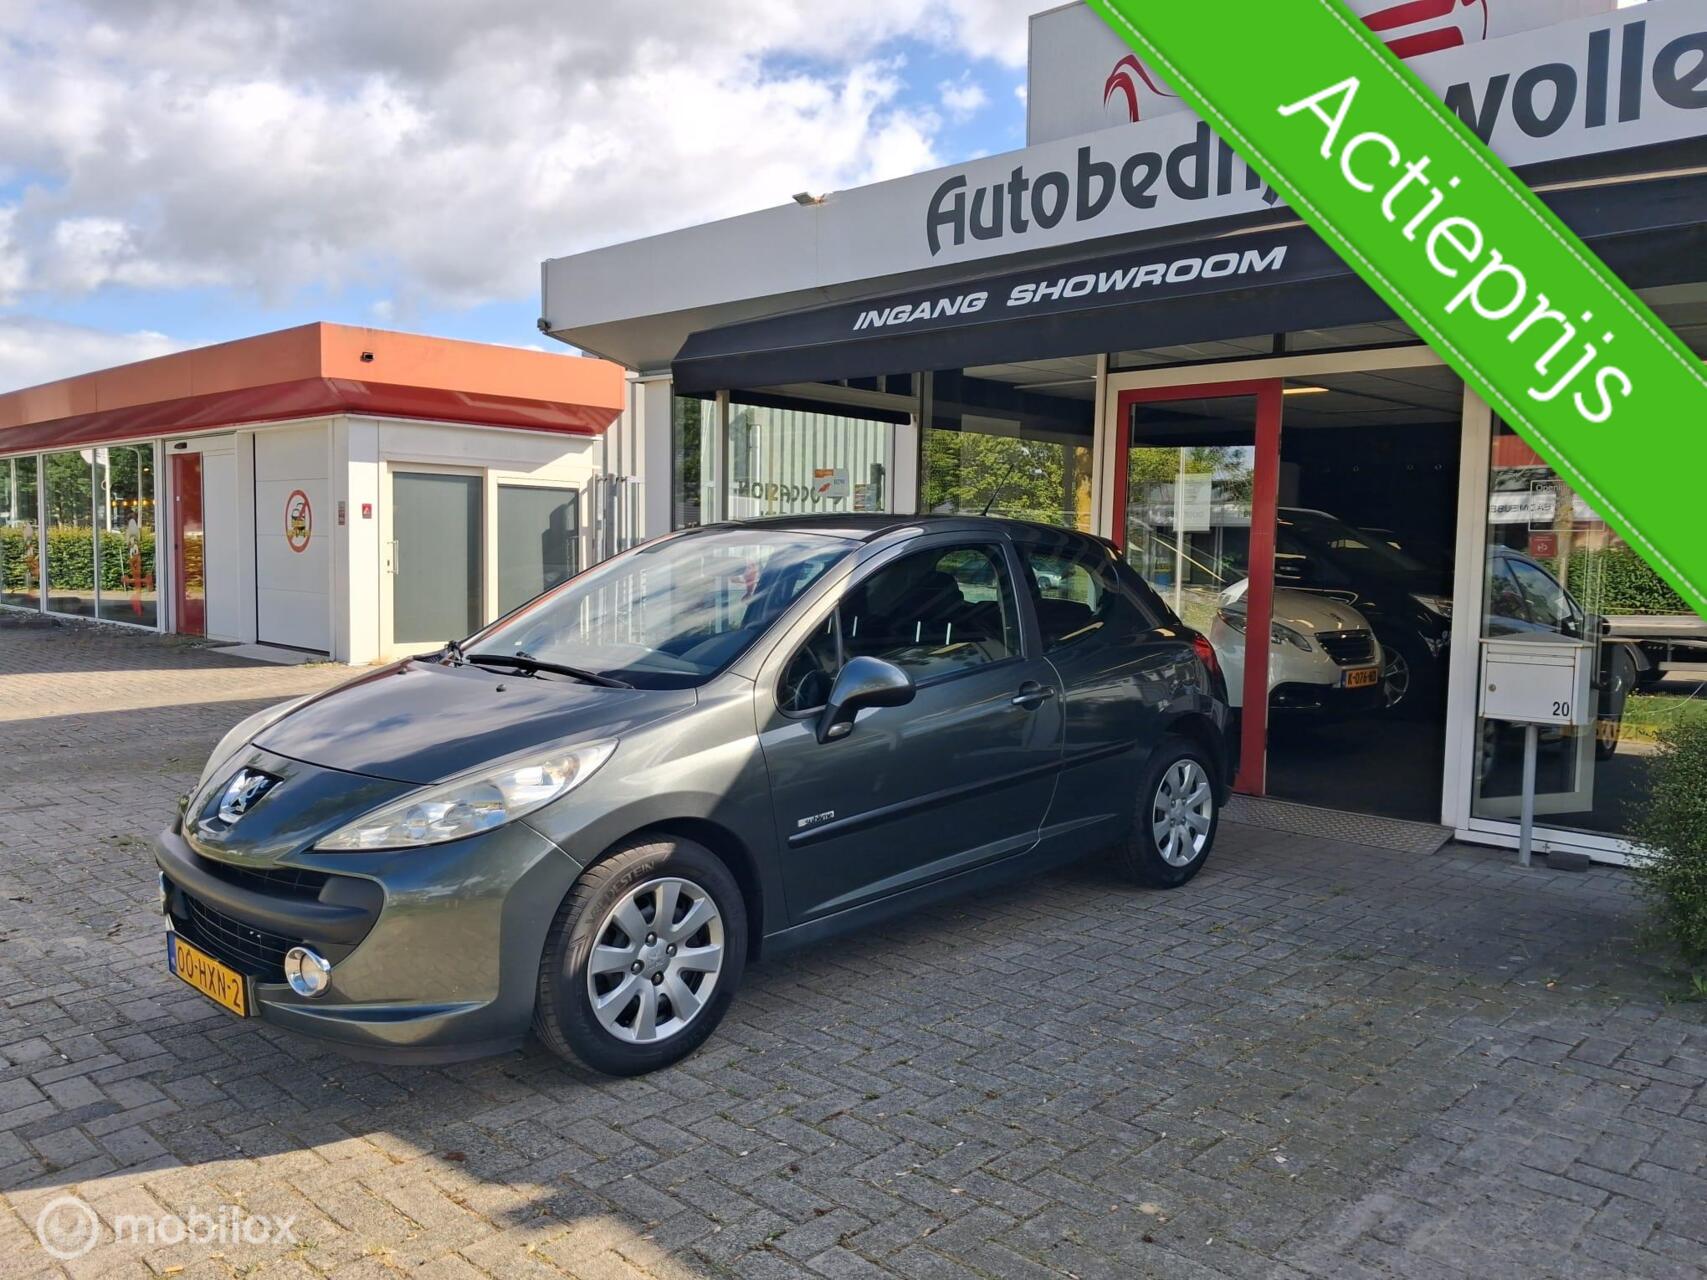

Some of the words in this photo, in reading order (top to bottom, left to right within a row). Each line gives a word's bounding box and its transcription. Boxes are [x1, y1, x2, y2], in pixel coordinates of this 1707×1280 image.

[926, 120, 1280, 256] Autobedr
[1443, 19, 1707, 147] wolle
[853, 291, 989, 331] INGANG
[1006, 245, 1288, 307] SHOWROOM
[1552, 701, 1570, 717] 20
[177, 946, 241, 1008] 00-HXN-2
